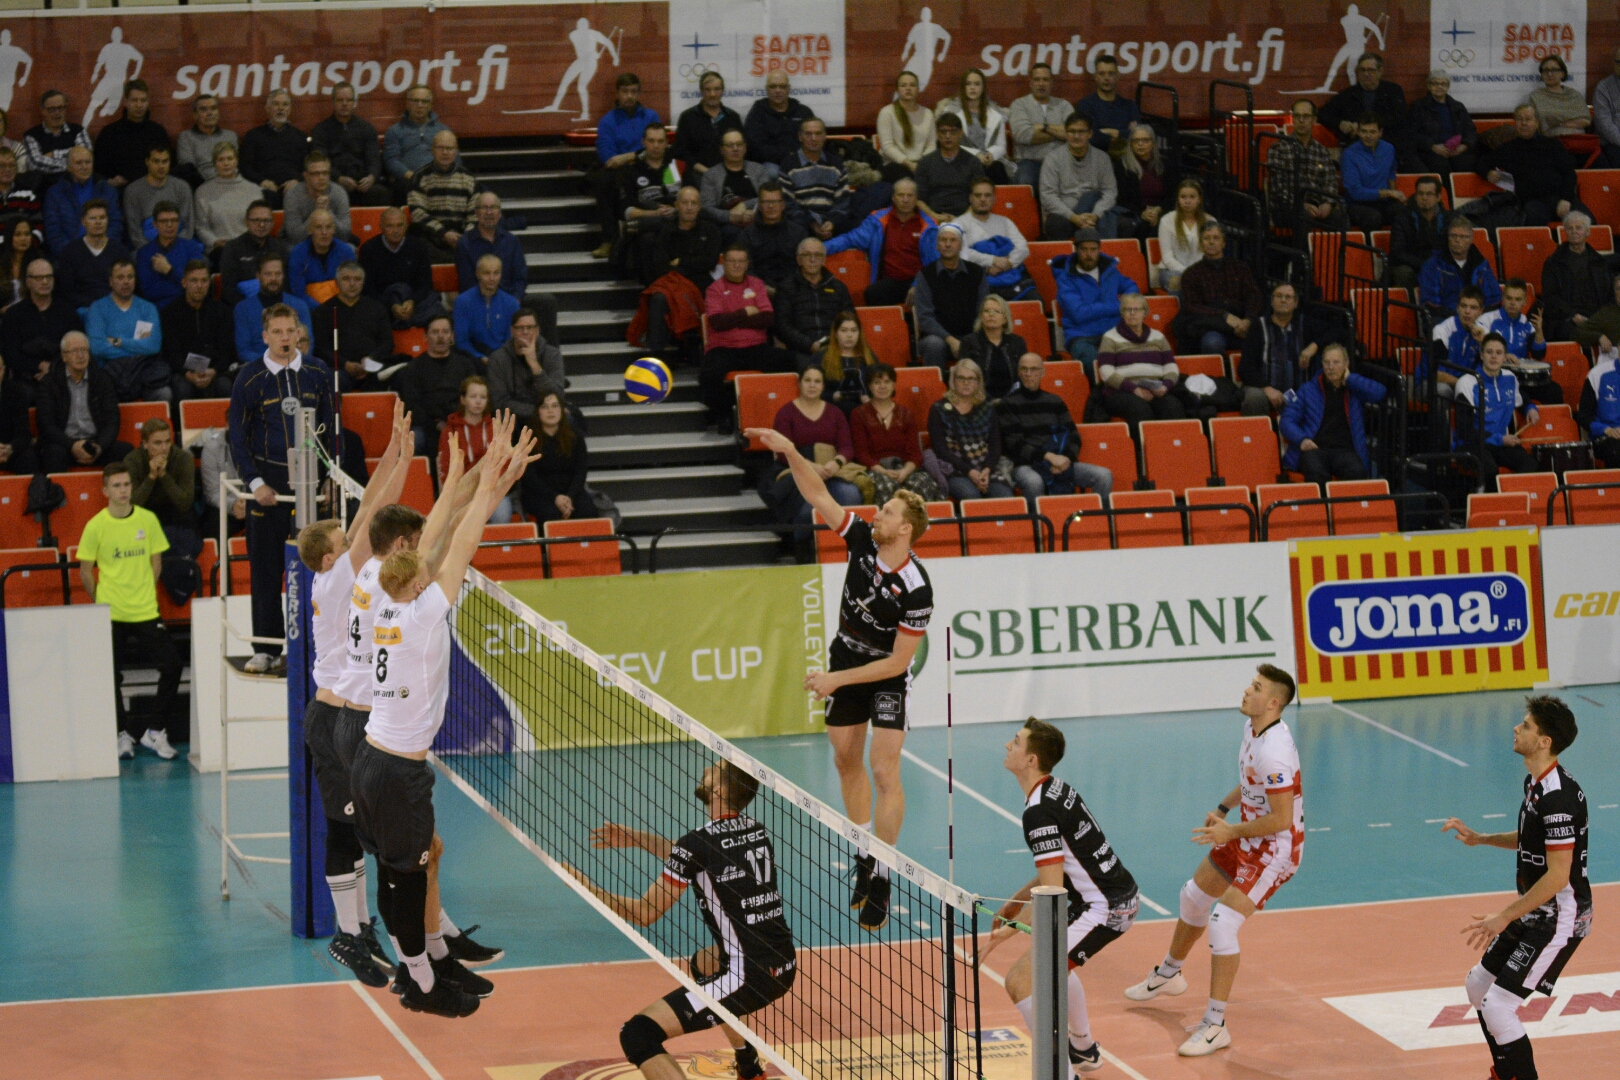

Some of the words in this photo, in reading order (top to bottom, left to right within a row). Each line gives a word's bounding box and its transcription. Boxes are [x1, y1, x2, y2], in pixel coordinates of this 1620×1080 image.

[752, 33, 832, 55] SANTA
[1504, 23, 1575, 43] SANTA
[750, 55, 832, 77] SPORT
[980, 27, 1285, 84] santasport.fi
[172, 44, 509, 107] santasport.fi
[1472, 74, 1505, 83] TRAINING
[721, 89, 754, 98] RAINING
[287, 570, 299, 640] KERKO
[951, 595, 1275, 660] SBERBANK
[802, 577, 827, 724] VOLLEYBLL
[375, 647, 388, 684] 8
[691, 646, 762, 682] CUP
[1266, 773, 1284, 785] STS
[344, 801, 355, 816] 6
[419, 850, 429, 866] 8
[745, 846, 771, 885] 17
[905, 863, 914, 876] CEV
